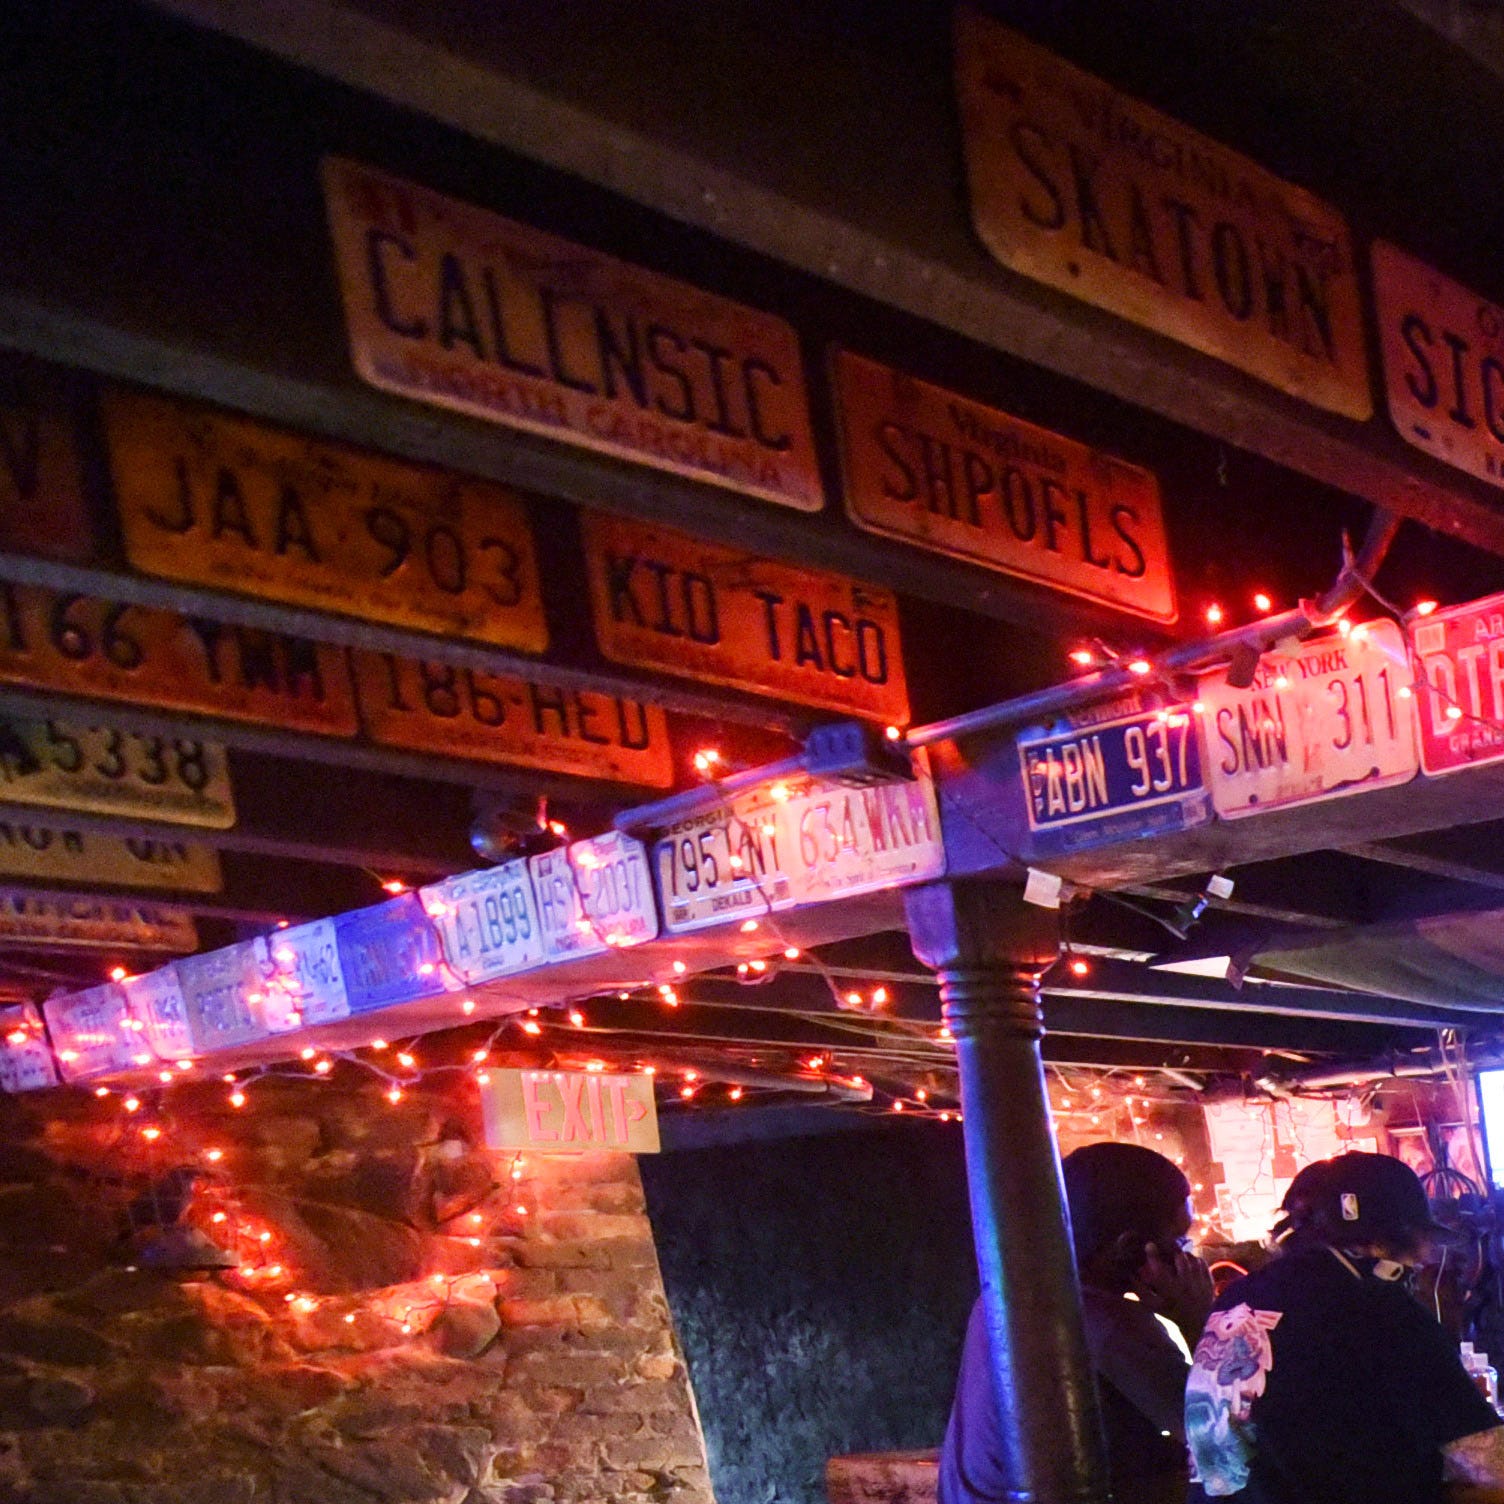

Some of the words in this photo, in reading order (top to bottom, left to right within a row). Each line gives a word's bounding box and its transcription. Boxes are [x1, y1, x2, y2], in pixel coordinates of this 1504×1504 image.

[363, 503, 524, 608] 903
[754, 588, 888, 685] TACO
[1299, 648, 1349, 681] YORK
[1327, 669, 1396, 751] 311
[1124, 713, 1190, 798] 937
[661, 833, 719, 898] 795
[520, 1069, 632, 1144] EXIT
